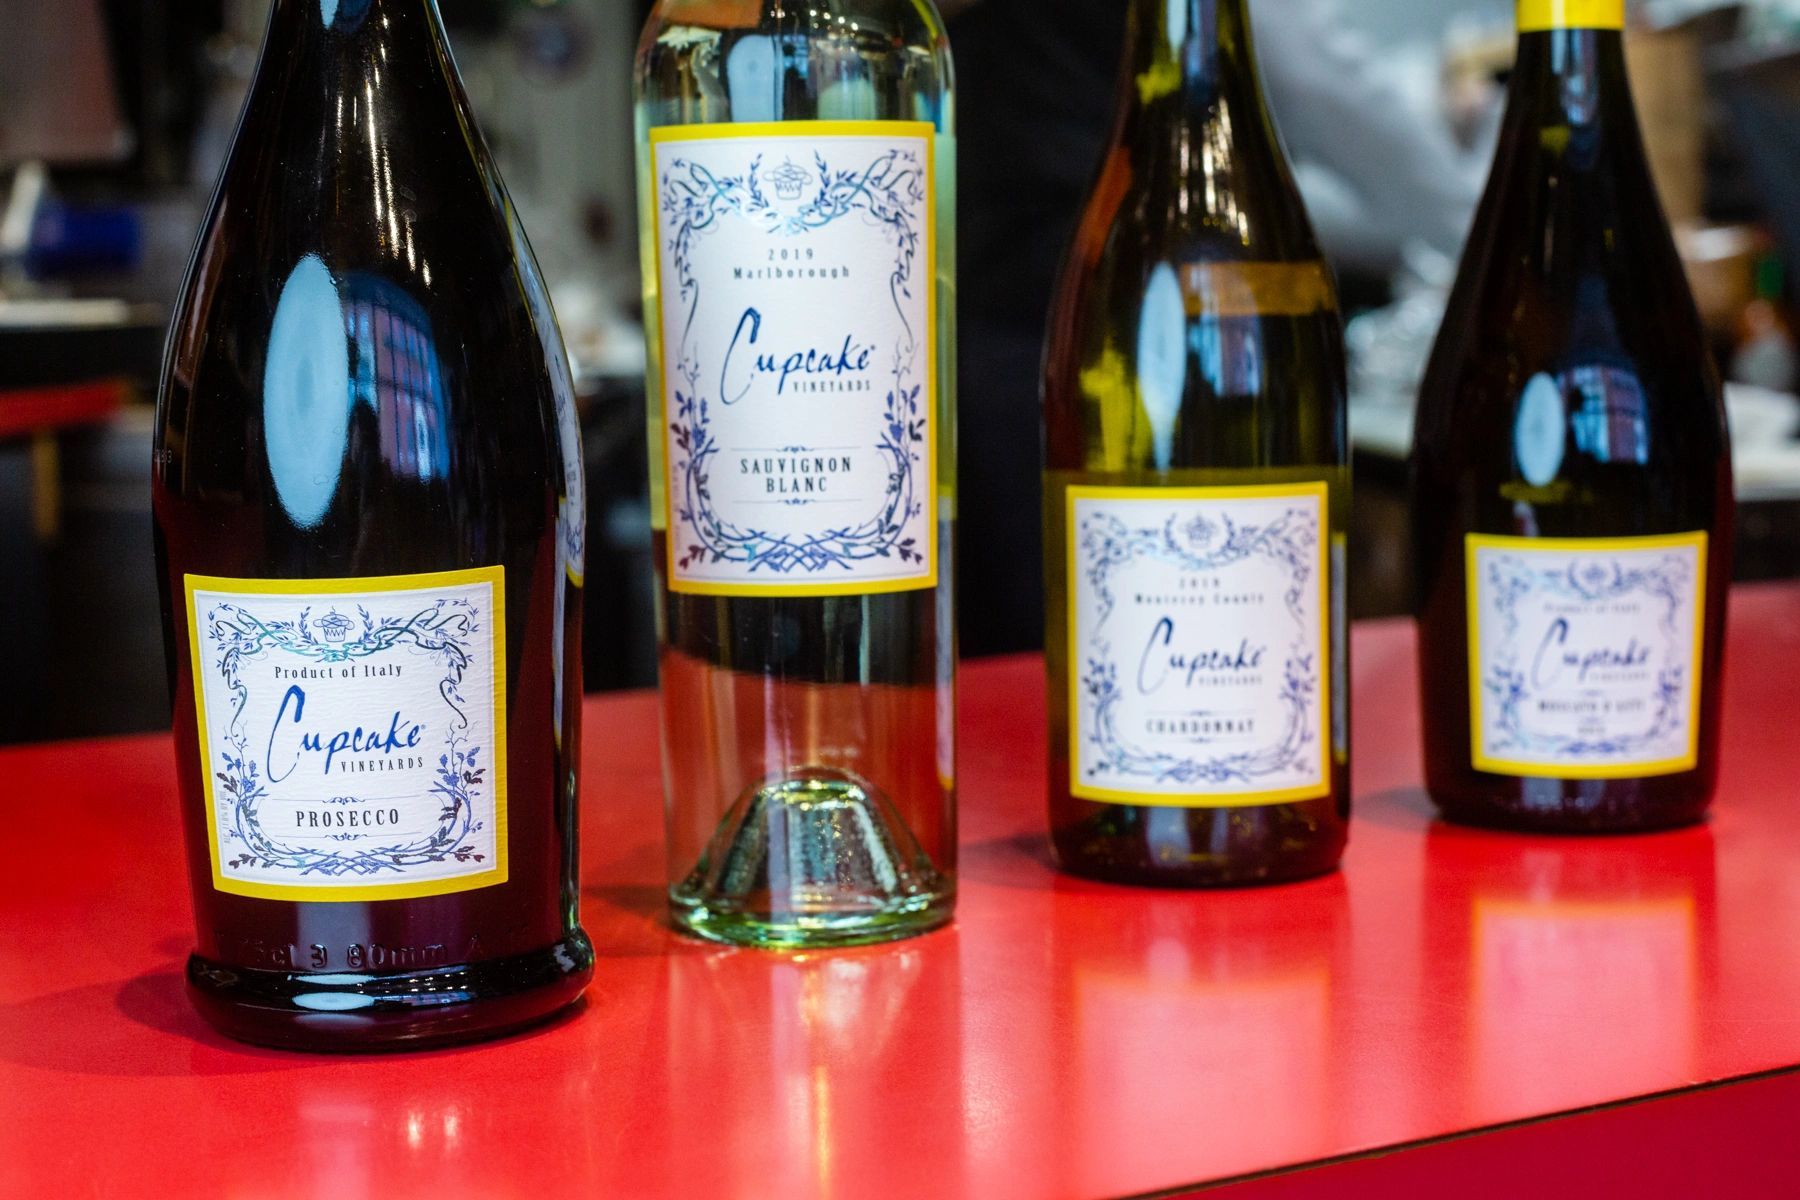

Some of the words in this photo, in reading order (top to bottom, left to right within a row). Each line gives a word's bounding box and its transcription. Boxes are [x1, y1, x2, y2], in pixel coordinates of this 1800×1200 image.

[768, 248, 814, 261] 2019
[733, 266, 850, 279] Marlborough
[720, 306, 869, 406] Cupcake
[793, 380, 871, 393] VINEYARDS
[740, 456, 852, 475] SAUVIGNON
[766, 476, 828, 493] BLANC
[1137, 616, 1267, 695] Cupcake
[274, 664, 334, 680] Product
[341, 664, 356, 679] of
[363, 663, 403, 679] Italy
[266, 684, 421, 783] Cupcake
[1146, 719, 1254, 734] CHARDONNAY
[341, 756, 425, 773] VINEYARDS
[295, 808, 400, 828] PROSECCO
